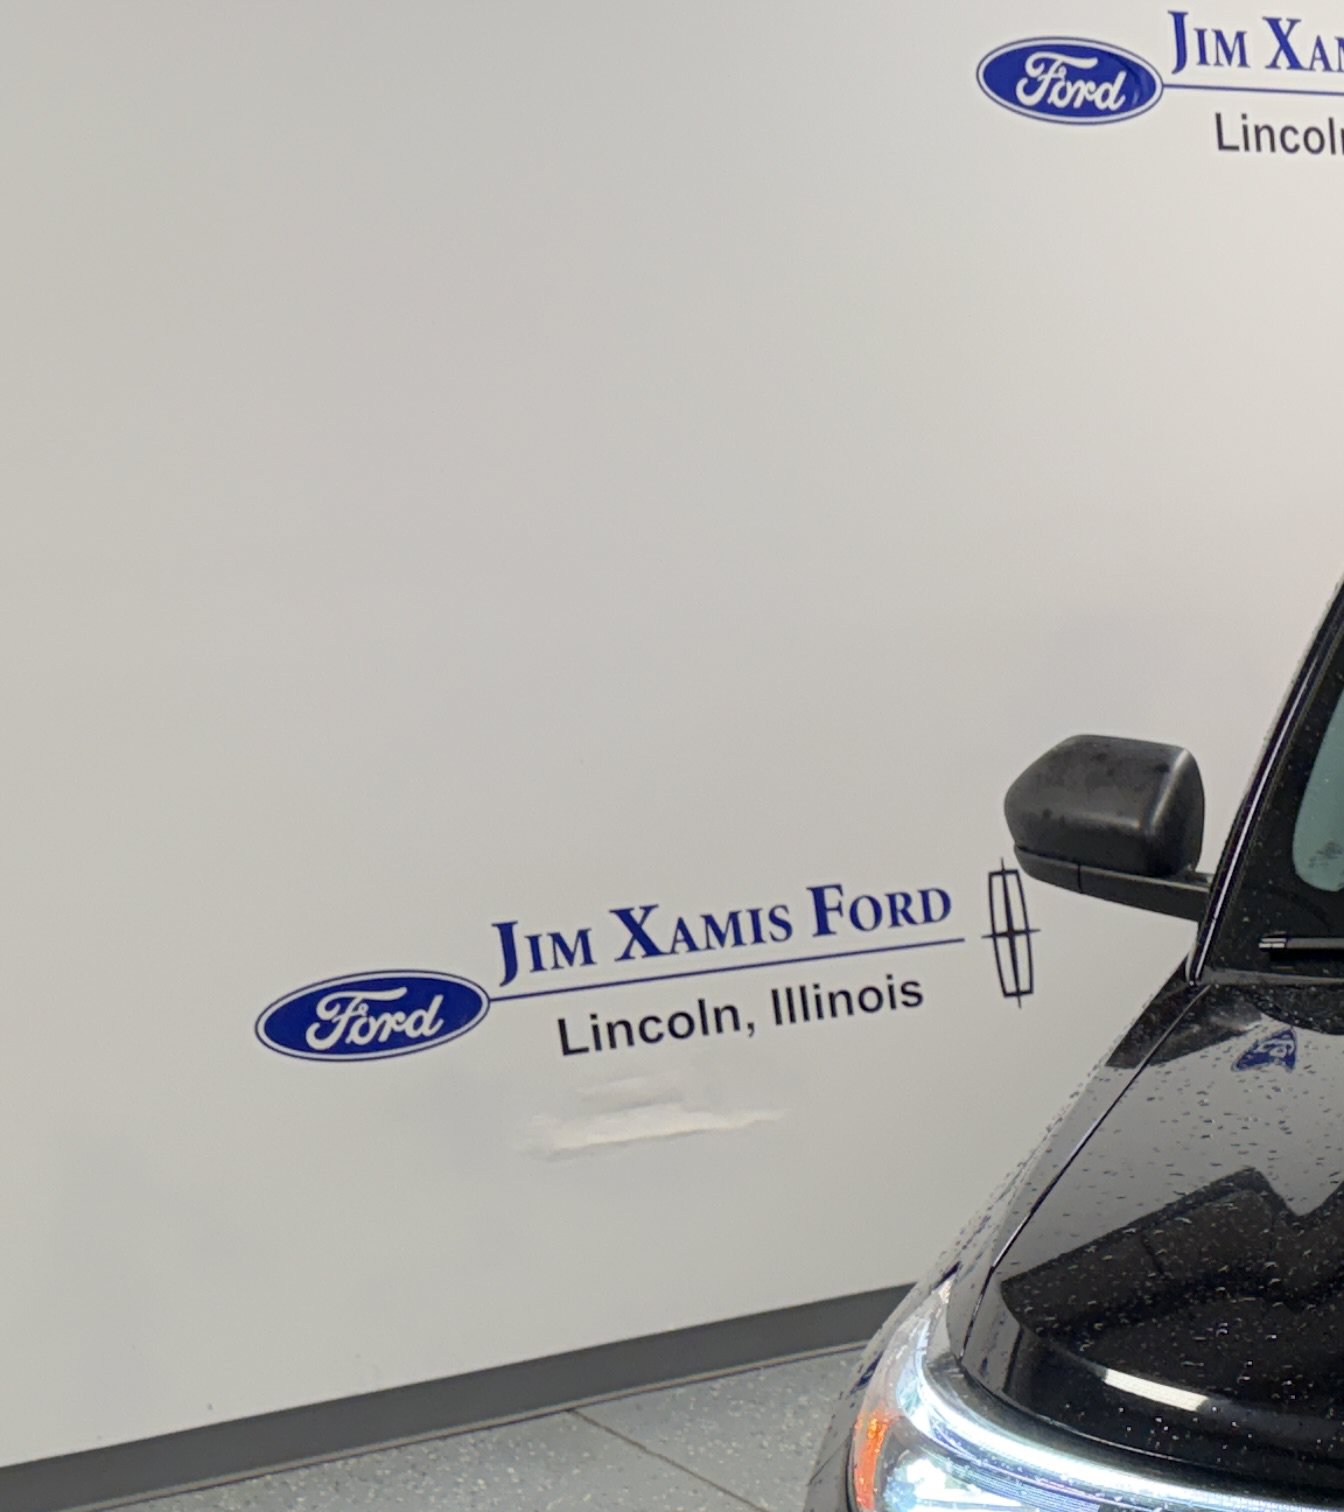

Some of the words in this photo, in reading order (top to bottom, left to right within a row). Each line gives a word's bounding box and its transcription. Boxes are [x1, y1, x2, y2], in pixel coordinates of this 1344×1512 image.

[1168, 11, 1248, 74] JIM
[1016, 50, 1126, 112] Ford
[492, 921, 594, 986] JIM
[610, 905, 793, 959] XAMIS
[807, 884, 951, 936] FORD
[304, 986, 444, 1050] Ford
[558, 999, 754, 1056] Lincoln,
[772, 974, 923, 1025] Illinois
